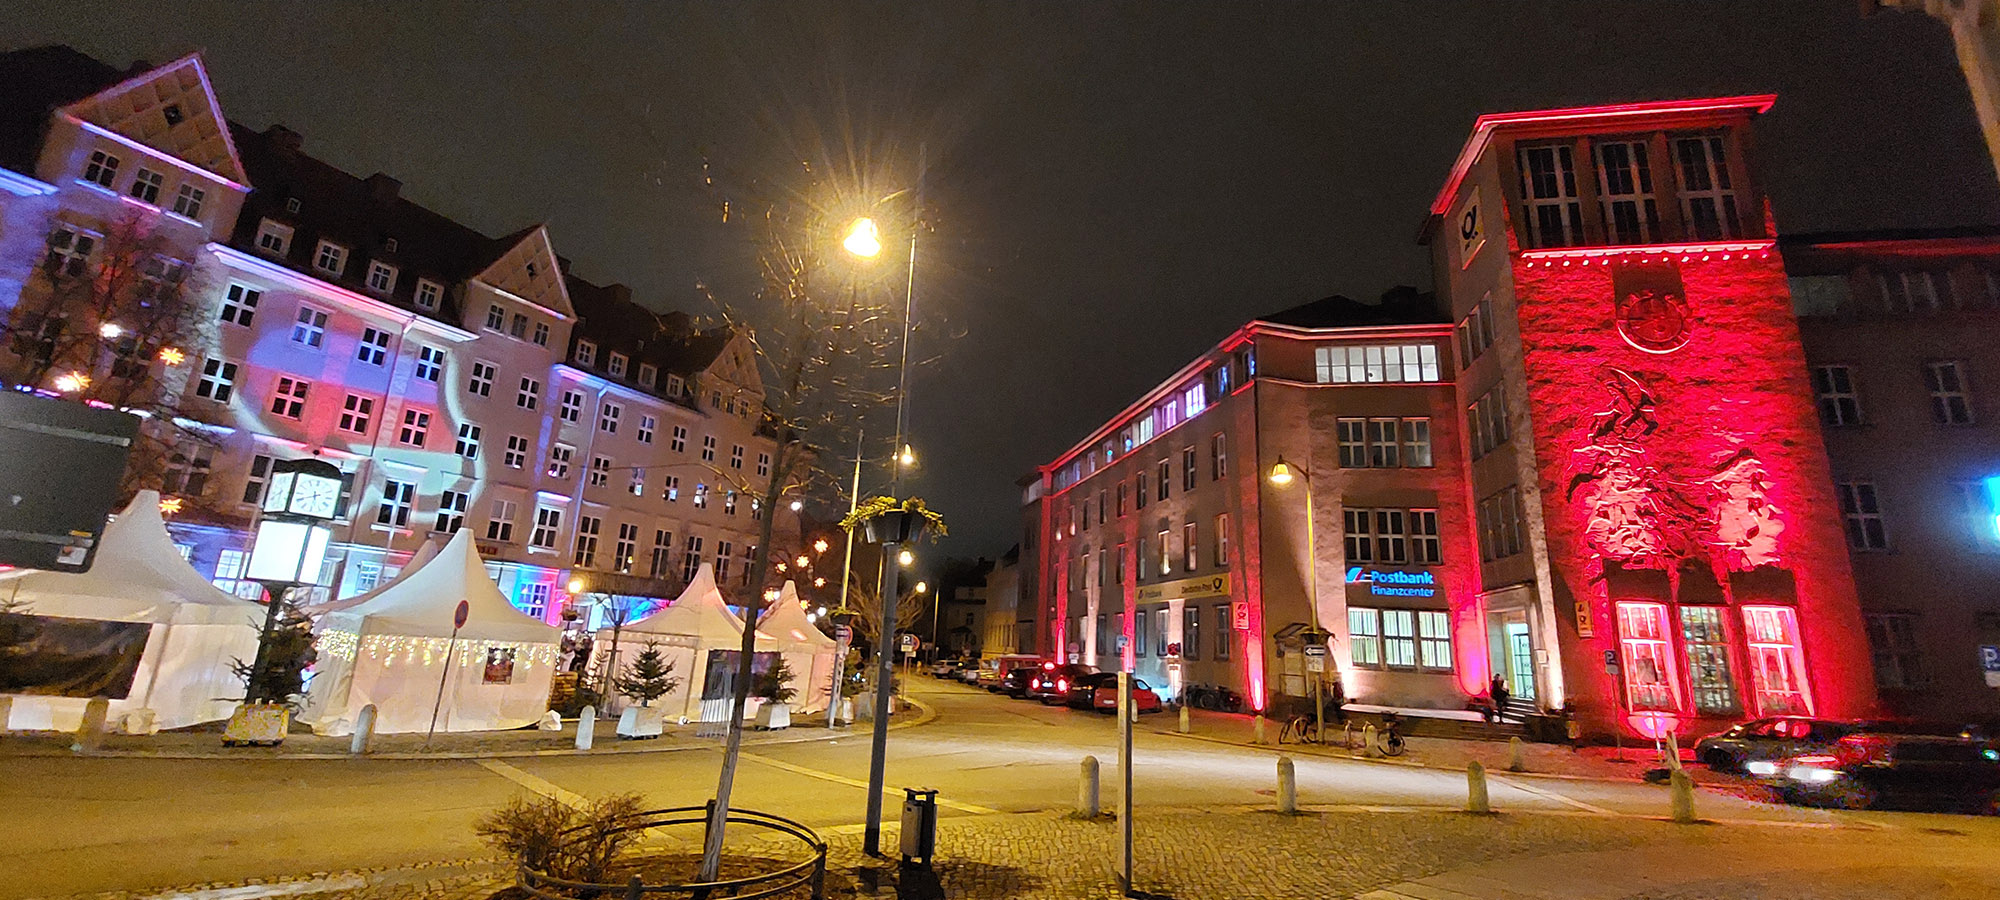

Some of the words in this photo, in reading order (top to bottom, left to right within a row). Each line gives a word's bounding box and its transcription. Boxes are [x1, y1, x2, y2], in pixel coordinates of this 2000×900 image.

[1370, 570, 1433, 584] Postbank
[1371, 585, 1435, 597] Finanzcenter
[1983, 648, 1998, 668] P
